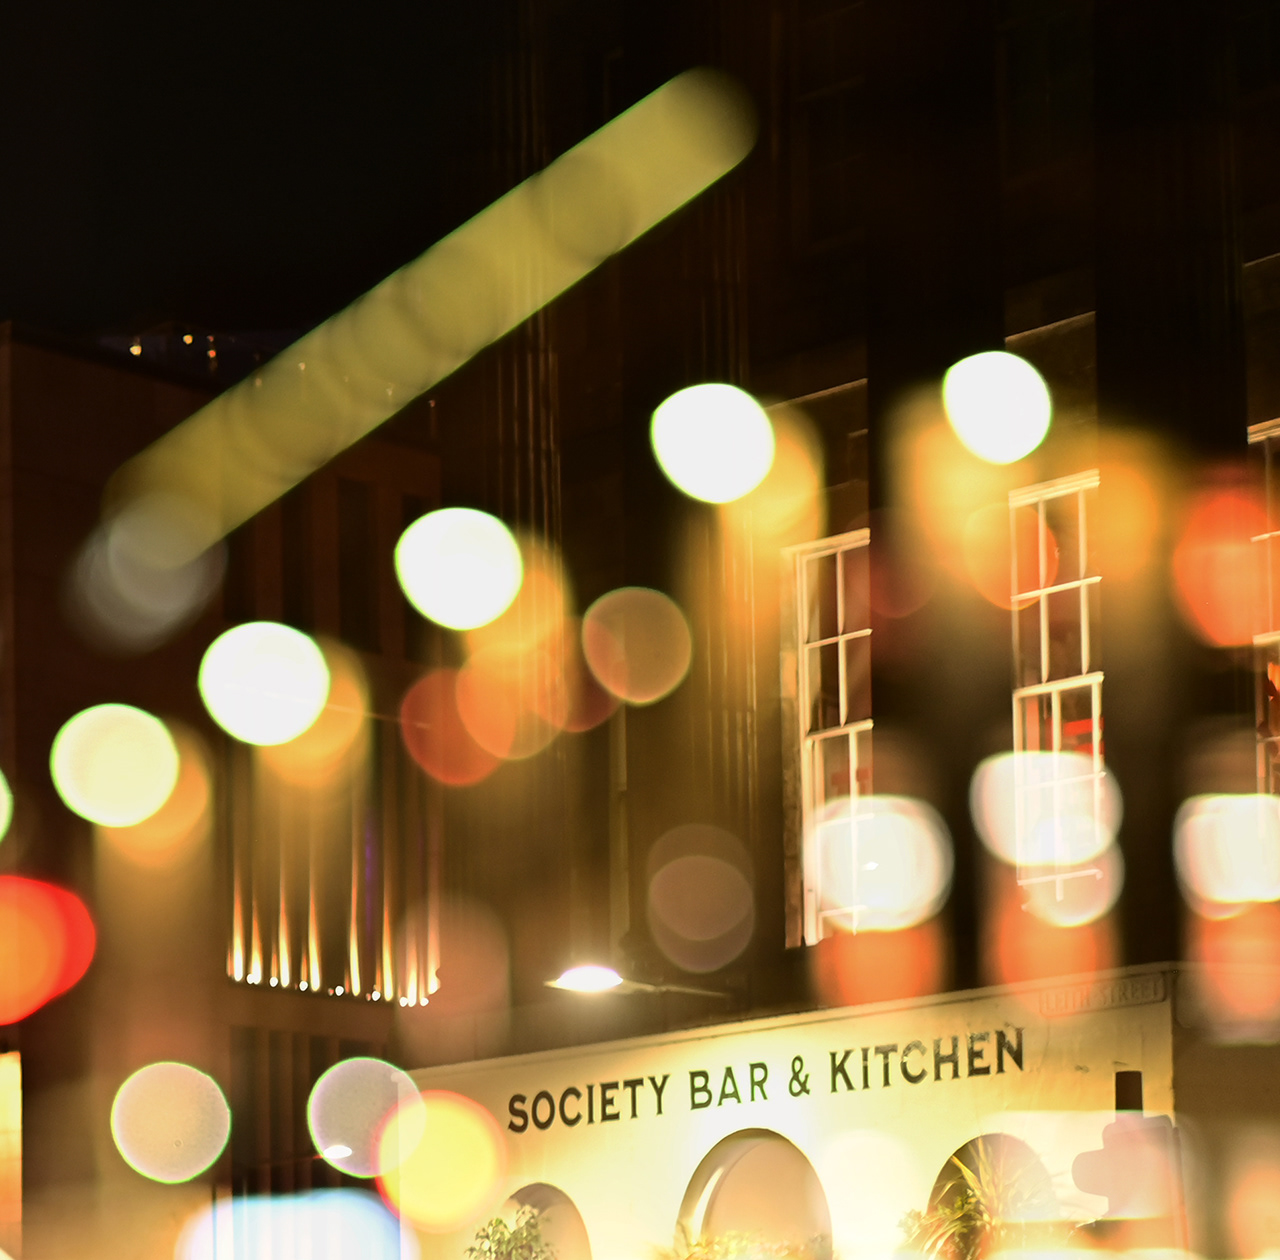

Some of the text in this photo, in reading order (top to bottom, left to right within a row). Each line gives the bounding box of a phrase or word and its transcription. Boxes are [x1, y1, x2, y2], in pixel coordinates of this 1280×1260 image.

[507, 1027, 1025, 1133] SOCIETY BAR & KITCHEN
